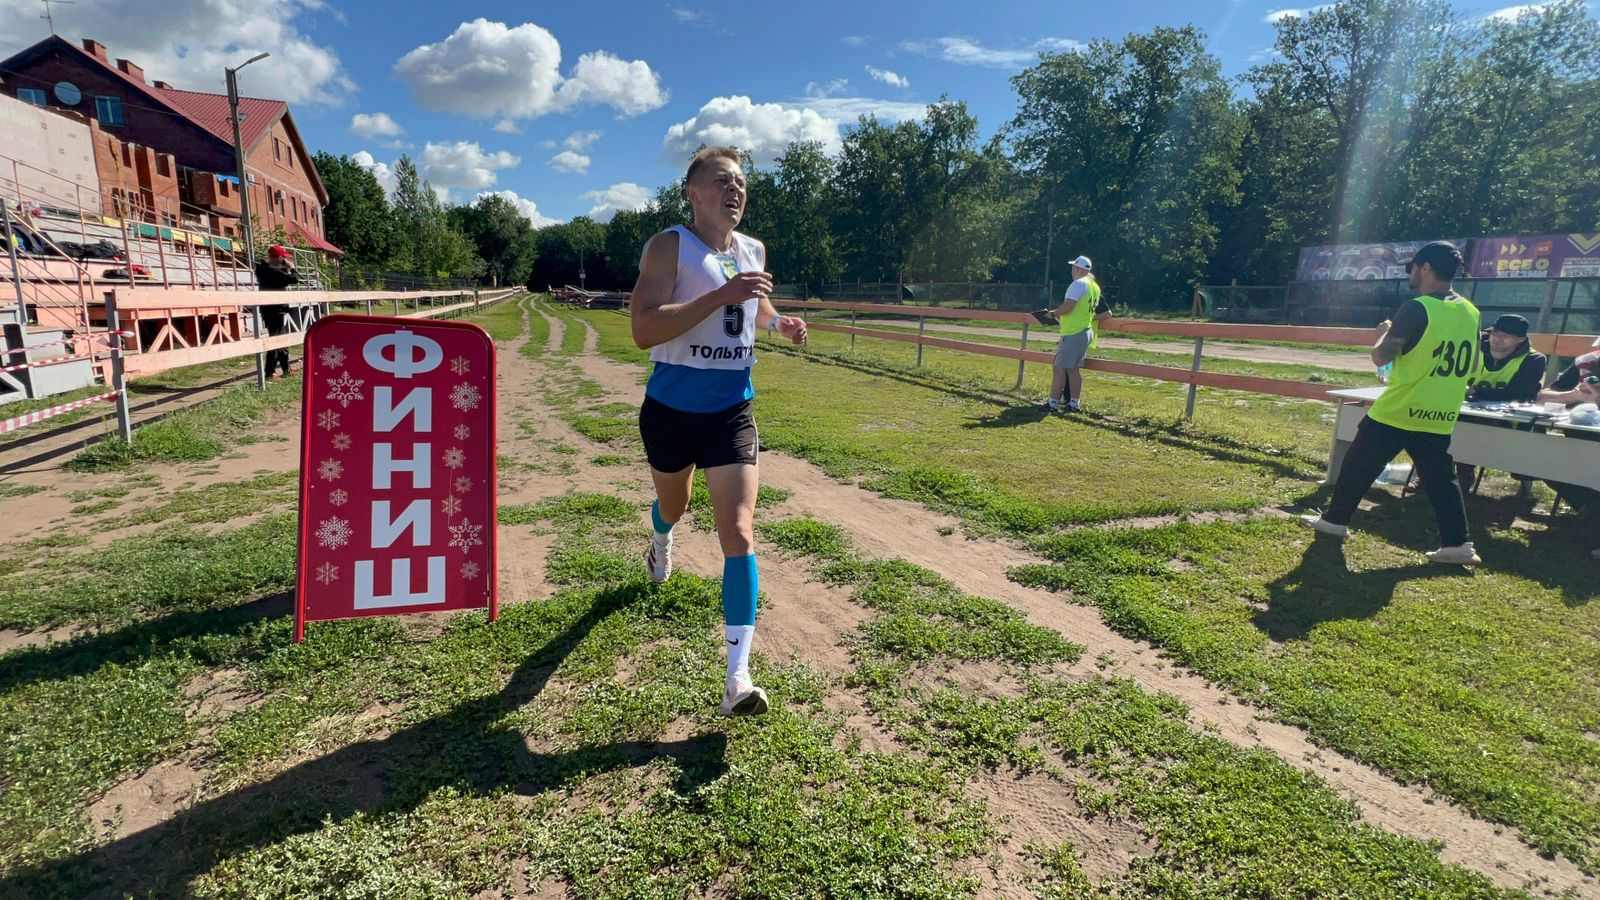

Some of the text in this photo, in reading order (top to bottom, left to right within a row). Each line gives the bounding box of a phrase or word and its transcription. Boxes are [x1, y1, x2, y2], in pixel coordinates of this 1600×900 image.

[723, 302, 746, 338] 5
[1429, 340, 1472, 378] 130
[1408, 408, 1456, 422] VIKING
[354, 330, 446, 610] ФИНИШ
